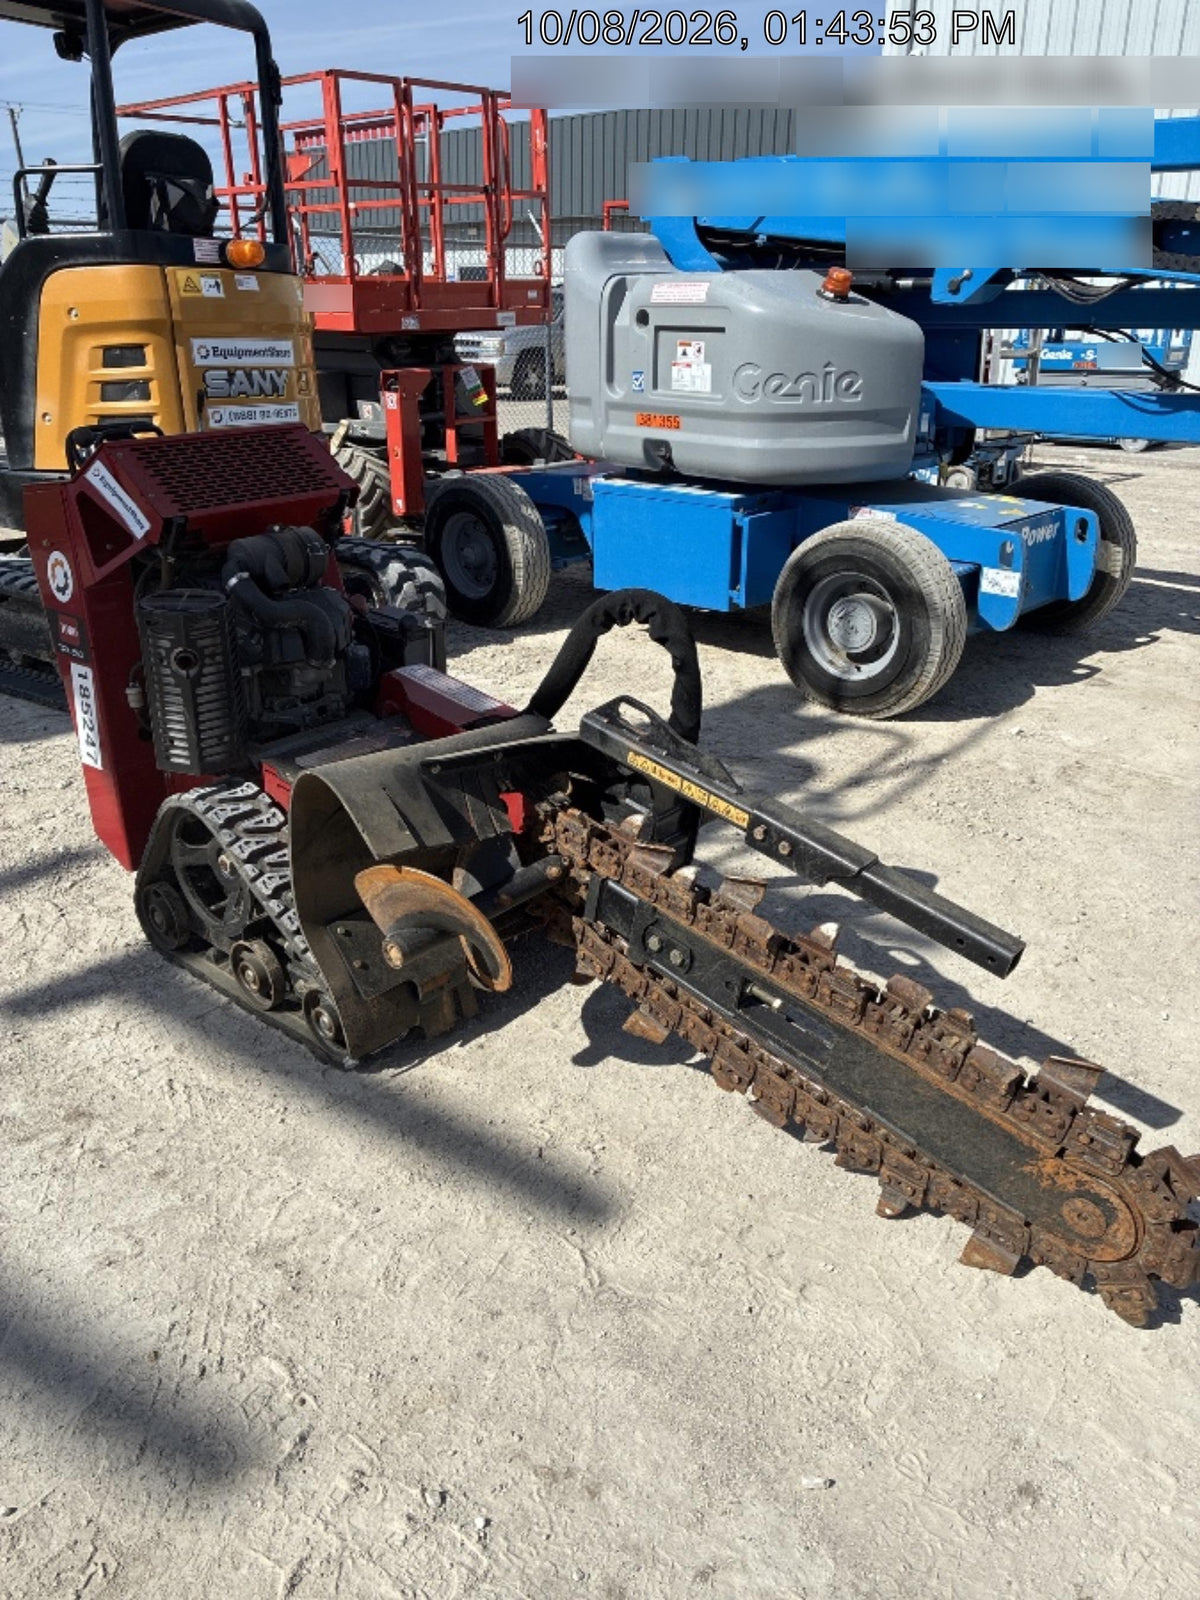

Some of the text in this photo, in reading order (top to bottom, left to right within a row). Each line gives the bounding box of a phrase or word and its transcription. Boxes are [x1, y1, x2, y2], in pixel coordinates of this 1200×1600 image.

[203, 369, 289, 398] SANY
[732, 361, 863, 404] Genie
[1021, 521, 1061, 548] Power
[77, 671, 99, 766] 185247
